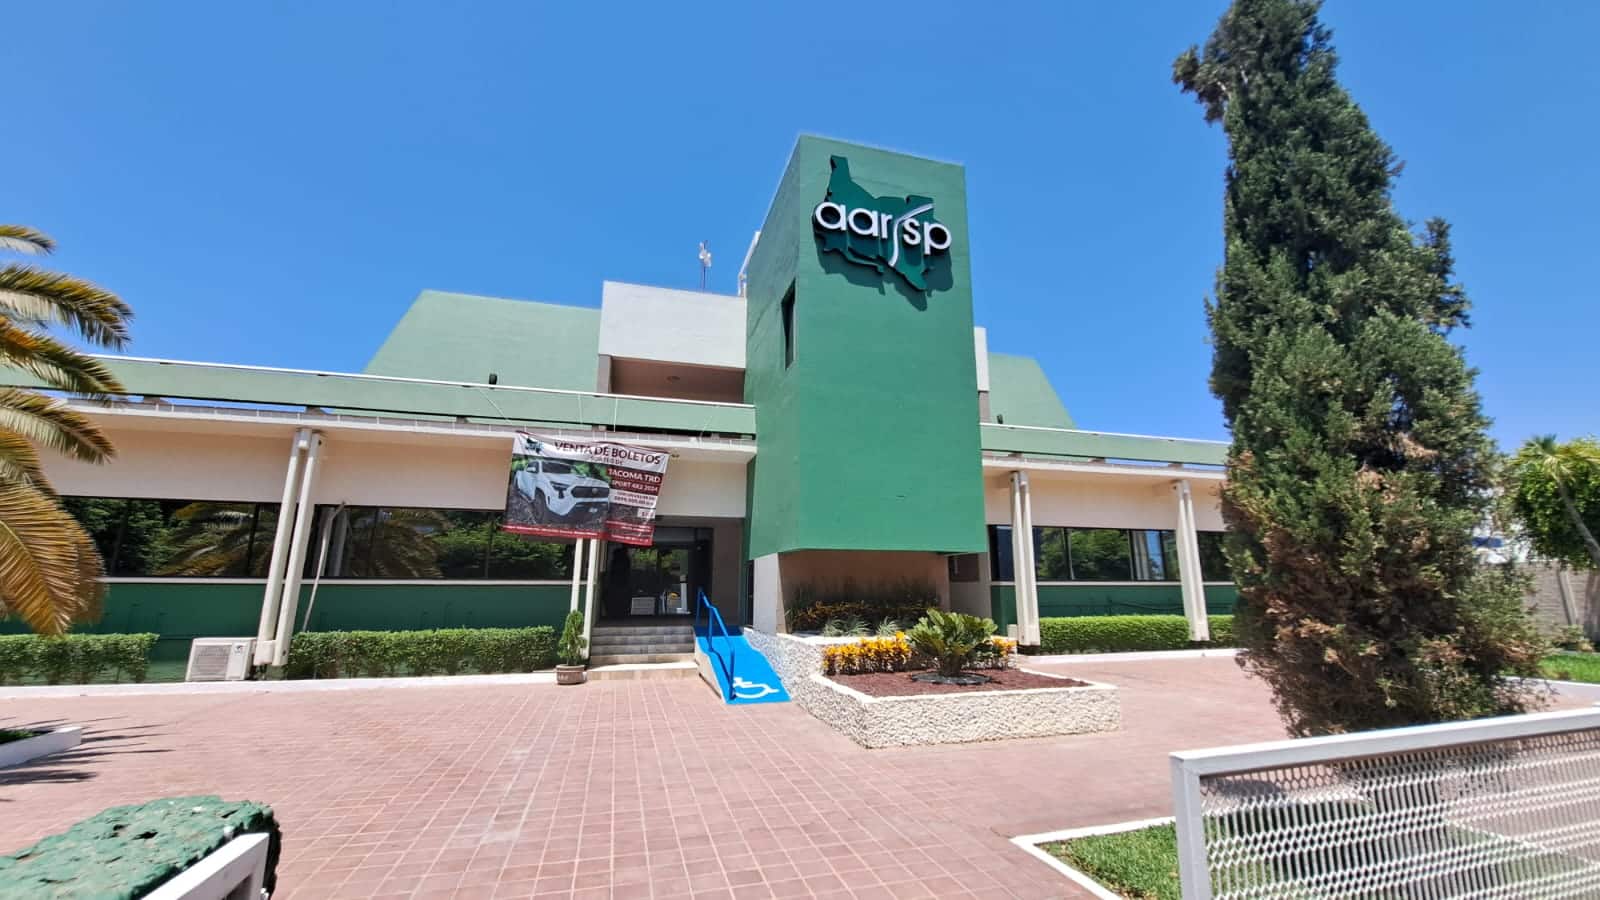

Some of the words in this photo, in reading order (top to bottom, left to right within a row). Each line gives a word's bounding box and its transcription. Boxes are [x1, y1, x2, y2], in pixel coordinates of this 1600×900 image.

[554, 441, 592, 454] VENTA
[594, 446, 609, 457] DE
[611, 448, 661, 464] BOLETOS
[608, 468, 643, 480] TACOMA
[644, 474, 661, 482] TRD
